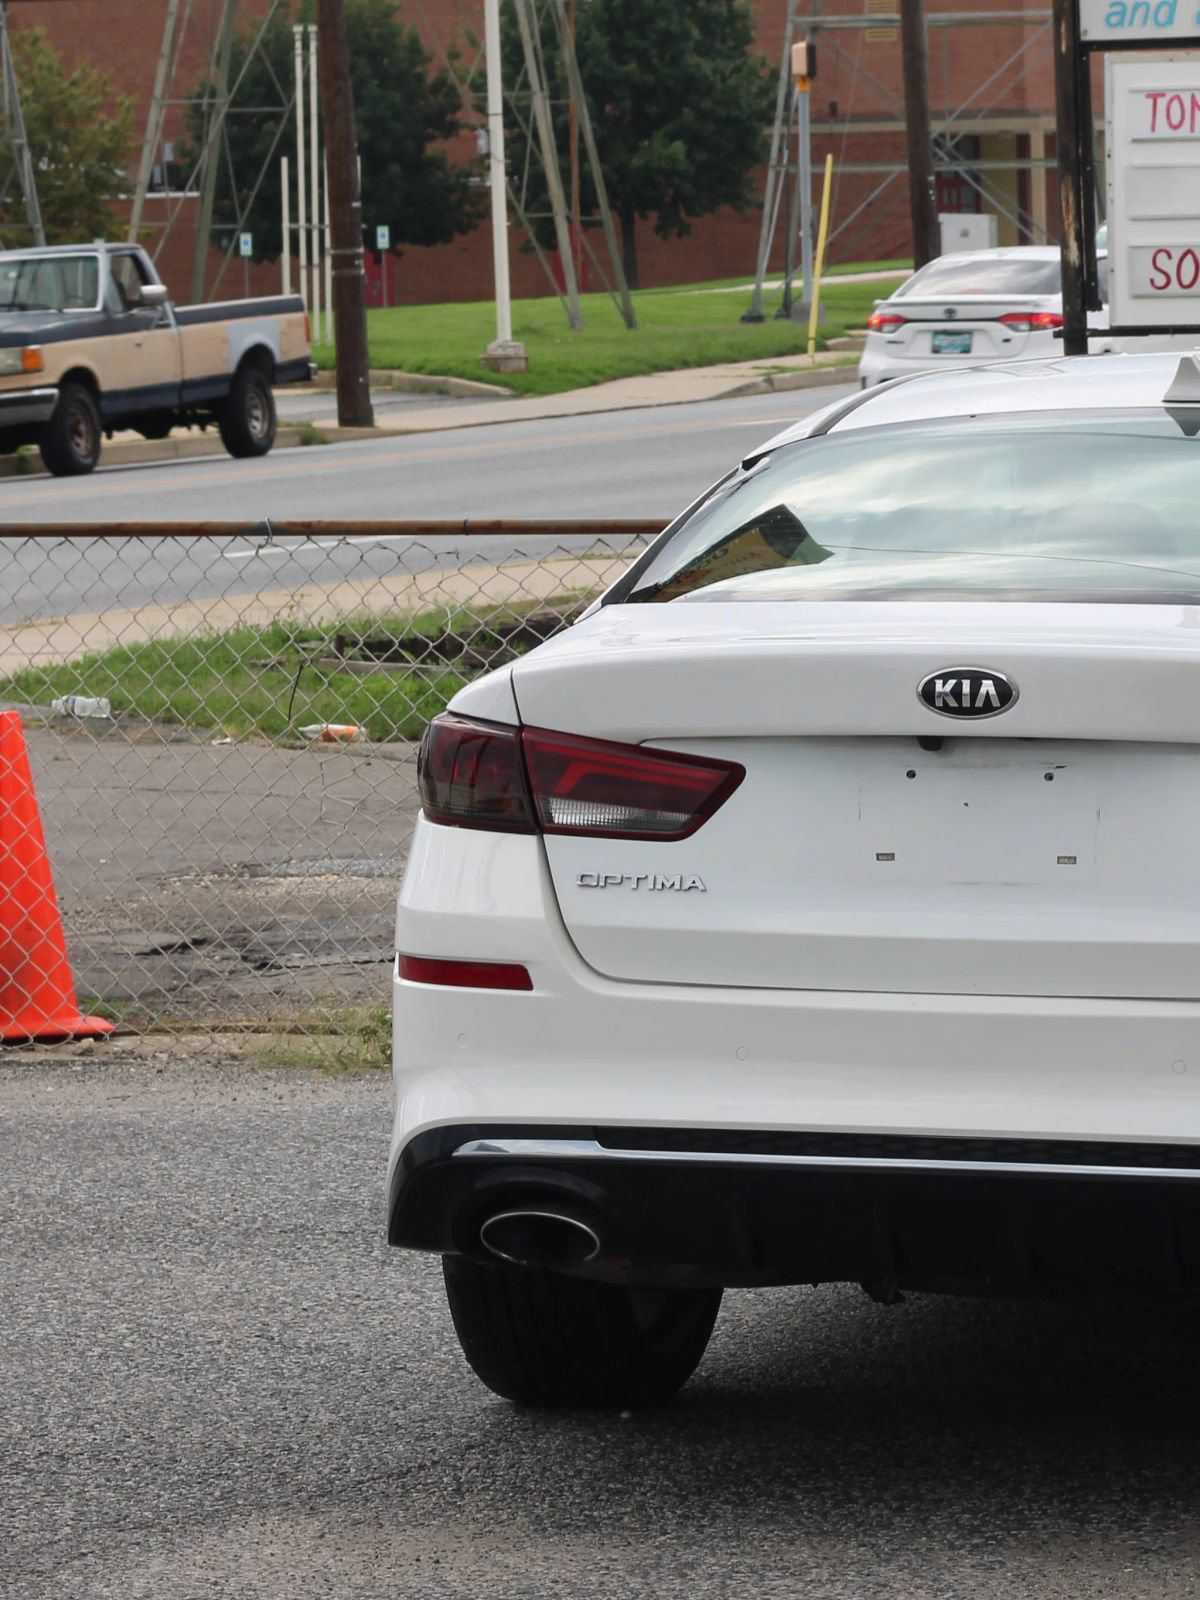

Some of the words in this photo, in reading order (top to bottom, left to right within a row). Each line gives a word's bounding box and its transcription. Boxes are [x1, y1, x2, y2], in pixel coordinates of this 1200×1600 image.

[1104, 0, 1179, 29] and
[934, 679, 1001, 707] KIA
[576, 871, 707, 892] OPTIMA
